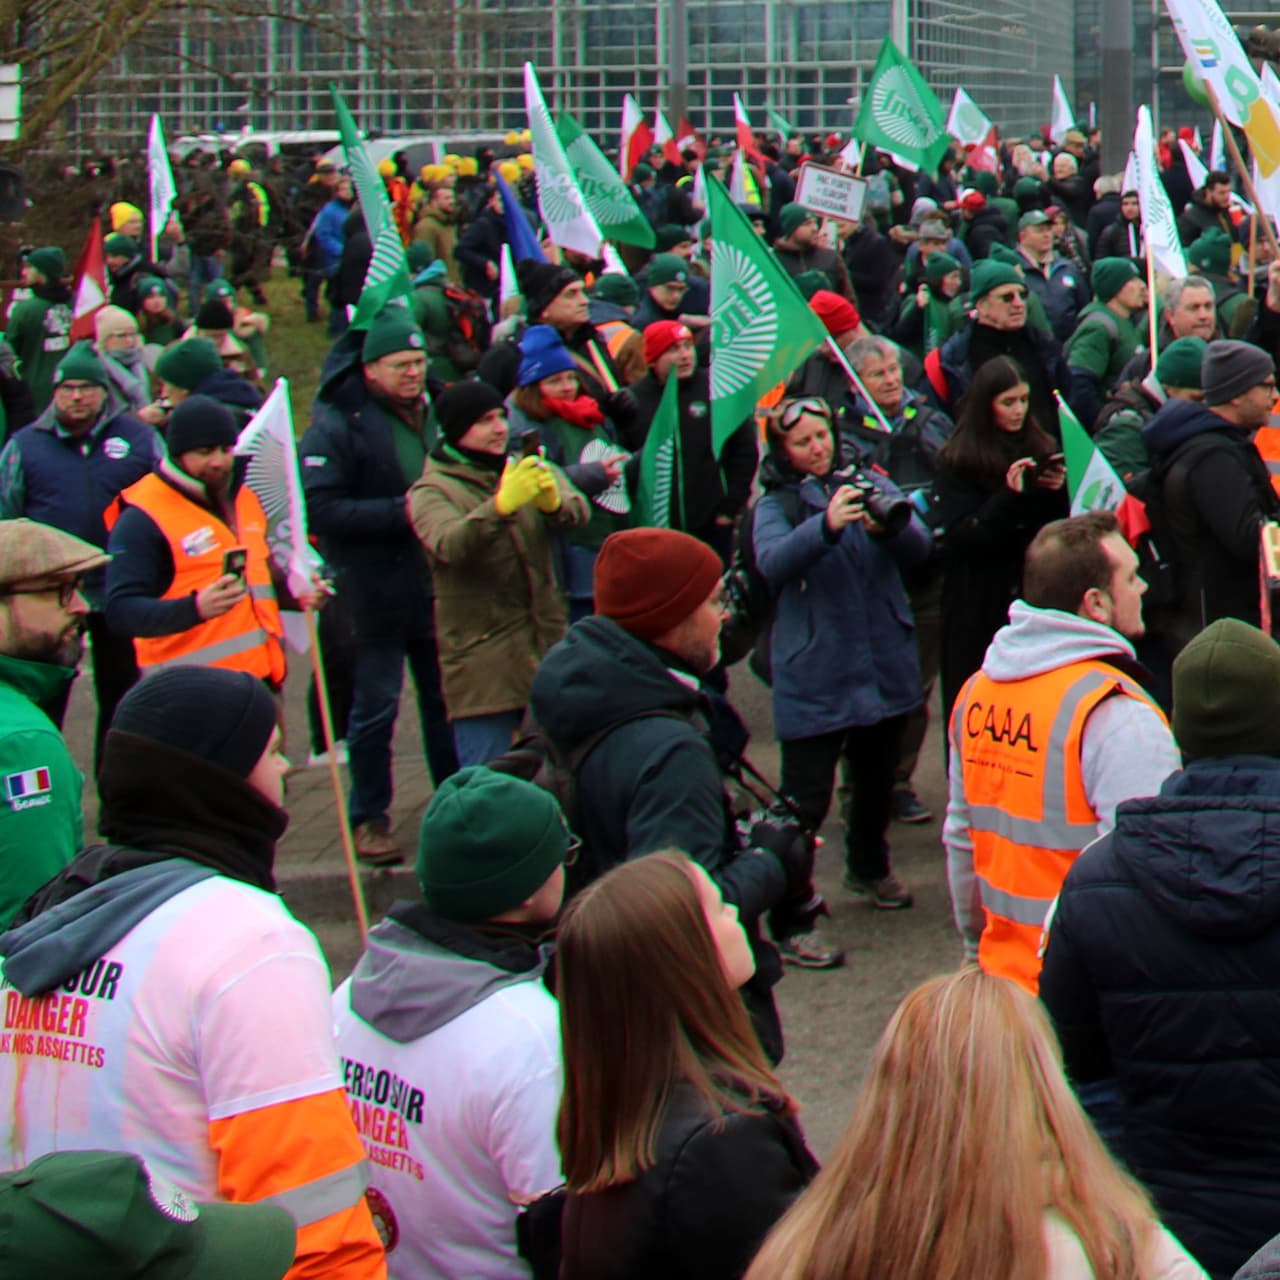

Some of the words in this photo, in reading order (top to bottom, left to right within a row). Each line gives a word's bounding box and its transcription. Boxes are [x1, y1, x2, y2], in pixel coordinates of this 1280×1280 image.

[967, 702, 1038, 753] CAAA
[4, 987, 90, 1039] DANGER
[13, 1032, 34, 1056] NOS
[37, 1035, 105, 1069] ASSIETTES
